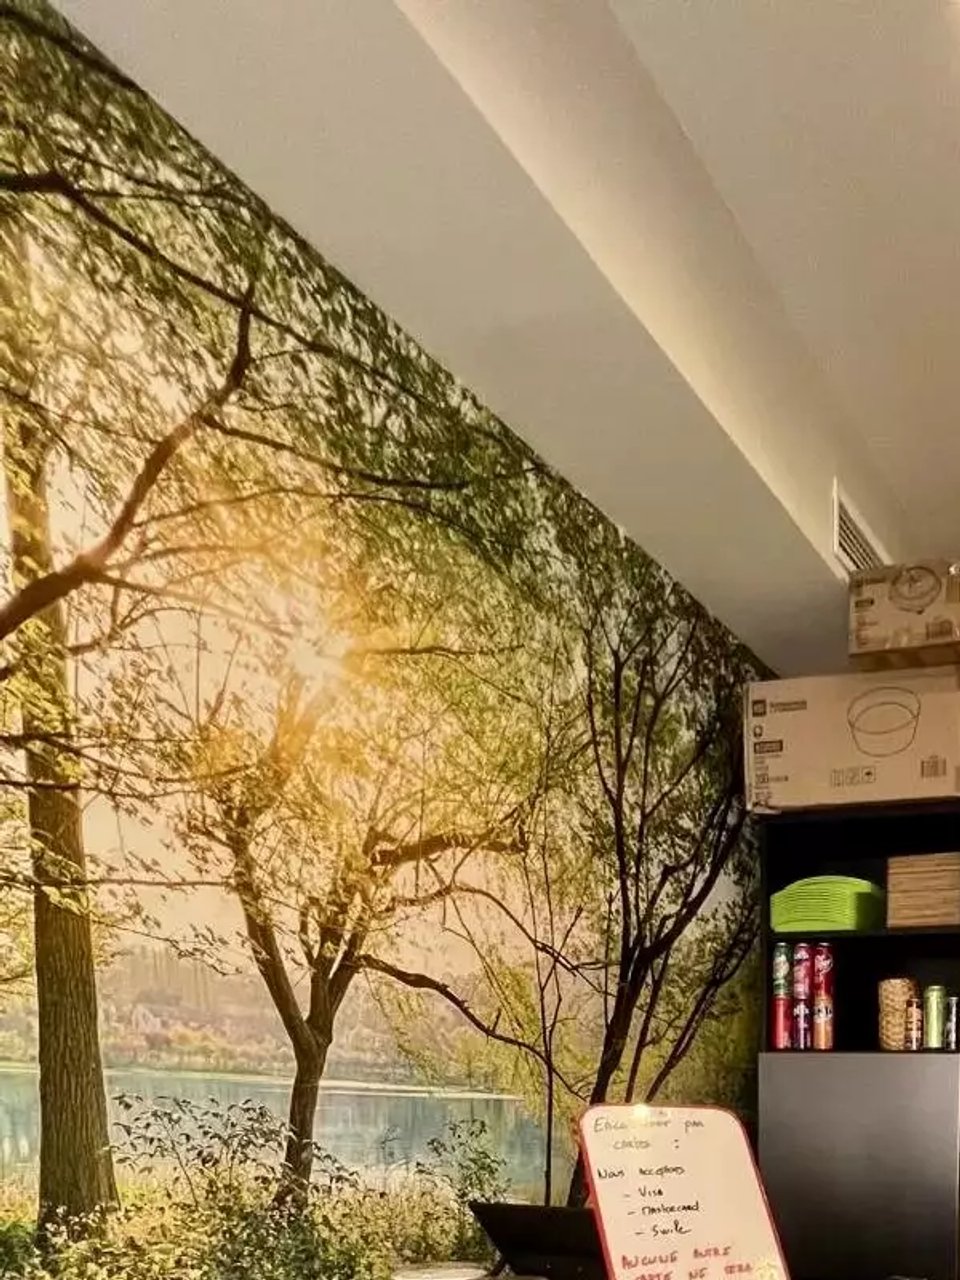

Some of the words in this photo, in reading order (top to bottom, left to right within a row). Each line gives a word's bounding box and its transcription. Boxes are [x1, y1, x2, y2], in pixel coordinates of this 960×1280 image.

[597, 1168, 625, 1179] Nous
[621, 1250, 679, 1270] AUCUNE
[693, 1246, 732, 1259] AUTRE
[688, 1267, 708, 1280] NE
